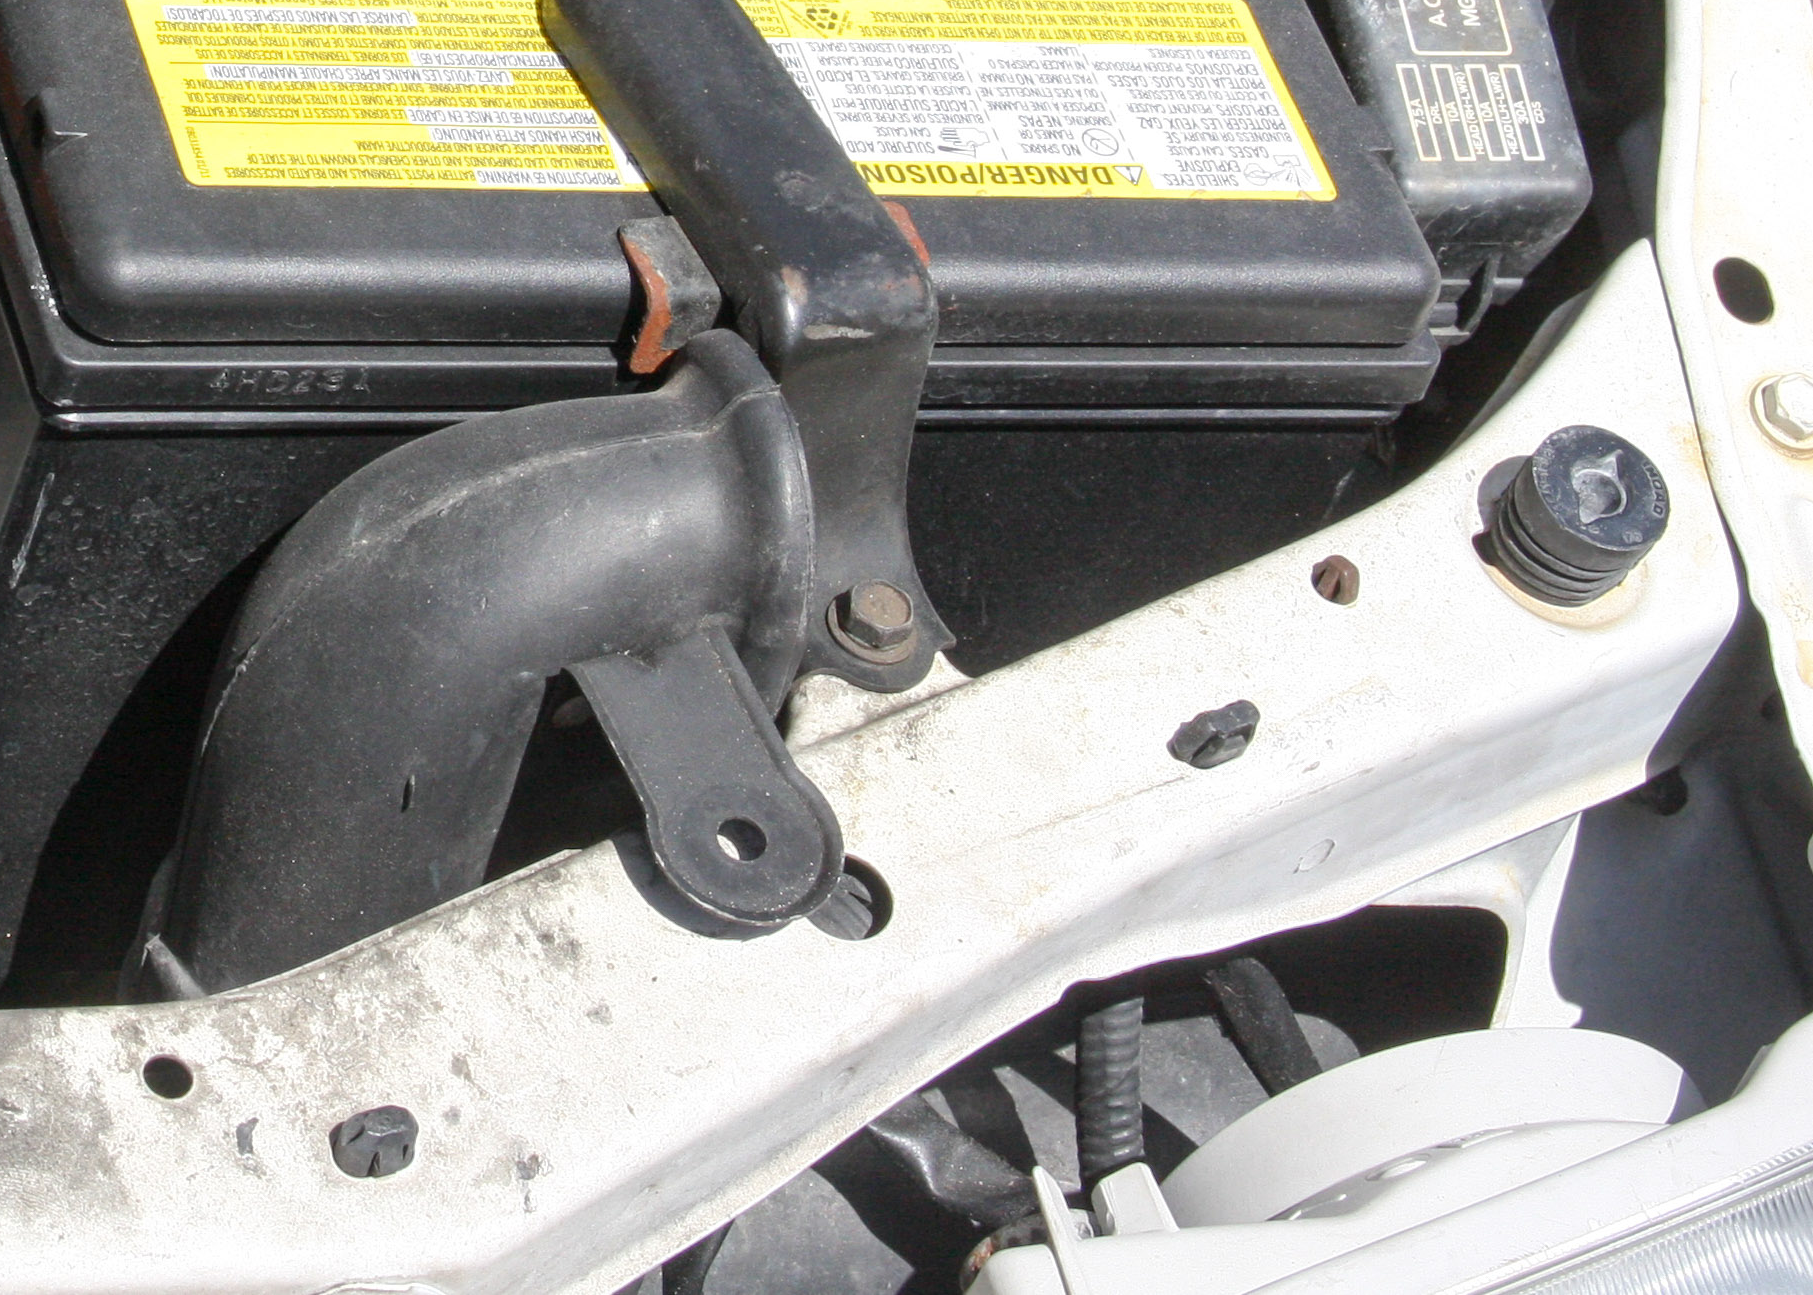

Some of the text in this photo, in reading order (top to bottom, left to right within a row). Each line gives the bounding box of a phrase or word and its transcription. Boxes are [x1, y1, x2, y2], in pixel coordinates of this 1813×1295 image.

[226, 8, 244, 21] DE
[294, 10, 339, 22] MANOS
[338, 10, 361, 23] LAS
[891, 56, 960, 70] SULFURICO
[1184, 62, 1259, 75] EXPLOSIVOS
[297, 66, 345, 79] CHAQUE
[381, 68, 422, 80] MAINS
[420, 68, 443, 81] LES
[854, 69, 871, 82] EL
[1013, 73, 1035, 85] NO
[1105, 74, 1266, 89] PROTEJA LOS GASES
[855, 97, 932, 111] SULFURIQUE
[930, 99, 979, 112] L'ACIDE
[407, 109, 598, 124] PROPOSITION 65 DE MISE EN GARDE
[1410, 98, 1427, 128] 7.5A
[1430, 101, 1443, 124] DRL
[1445, 101, 1461, 123] 10A
[1479, 101, 1495, 122] 10A
[1513, 100, 1529, 125] 30A
[1016, 114, 1063, 127] NE PAS
[1135, 116, 1164, 129] GAZ
[1198, 117, 1224, 129] LES
[1222, 117, 1287, 130] PROTEGER
[430, 127, 605, 143] WASH HANDS AFTER HANDLING!
[1163, 131, 1182, 143] SE
[843, 140, 936, 153] SULFURIC ACID
[1059, 143, 1082, 155] NO
[1174, 159, 1242, 172] EXPLOSIVE
[475, 170, 621, 184] PROPOSITION 65 WARNING
[856, 163, 1114, 185] DANGER/POISON
[1193, 173, 1239, 186] SHIELD
